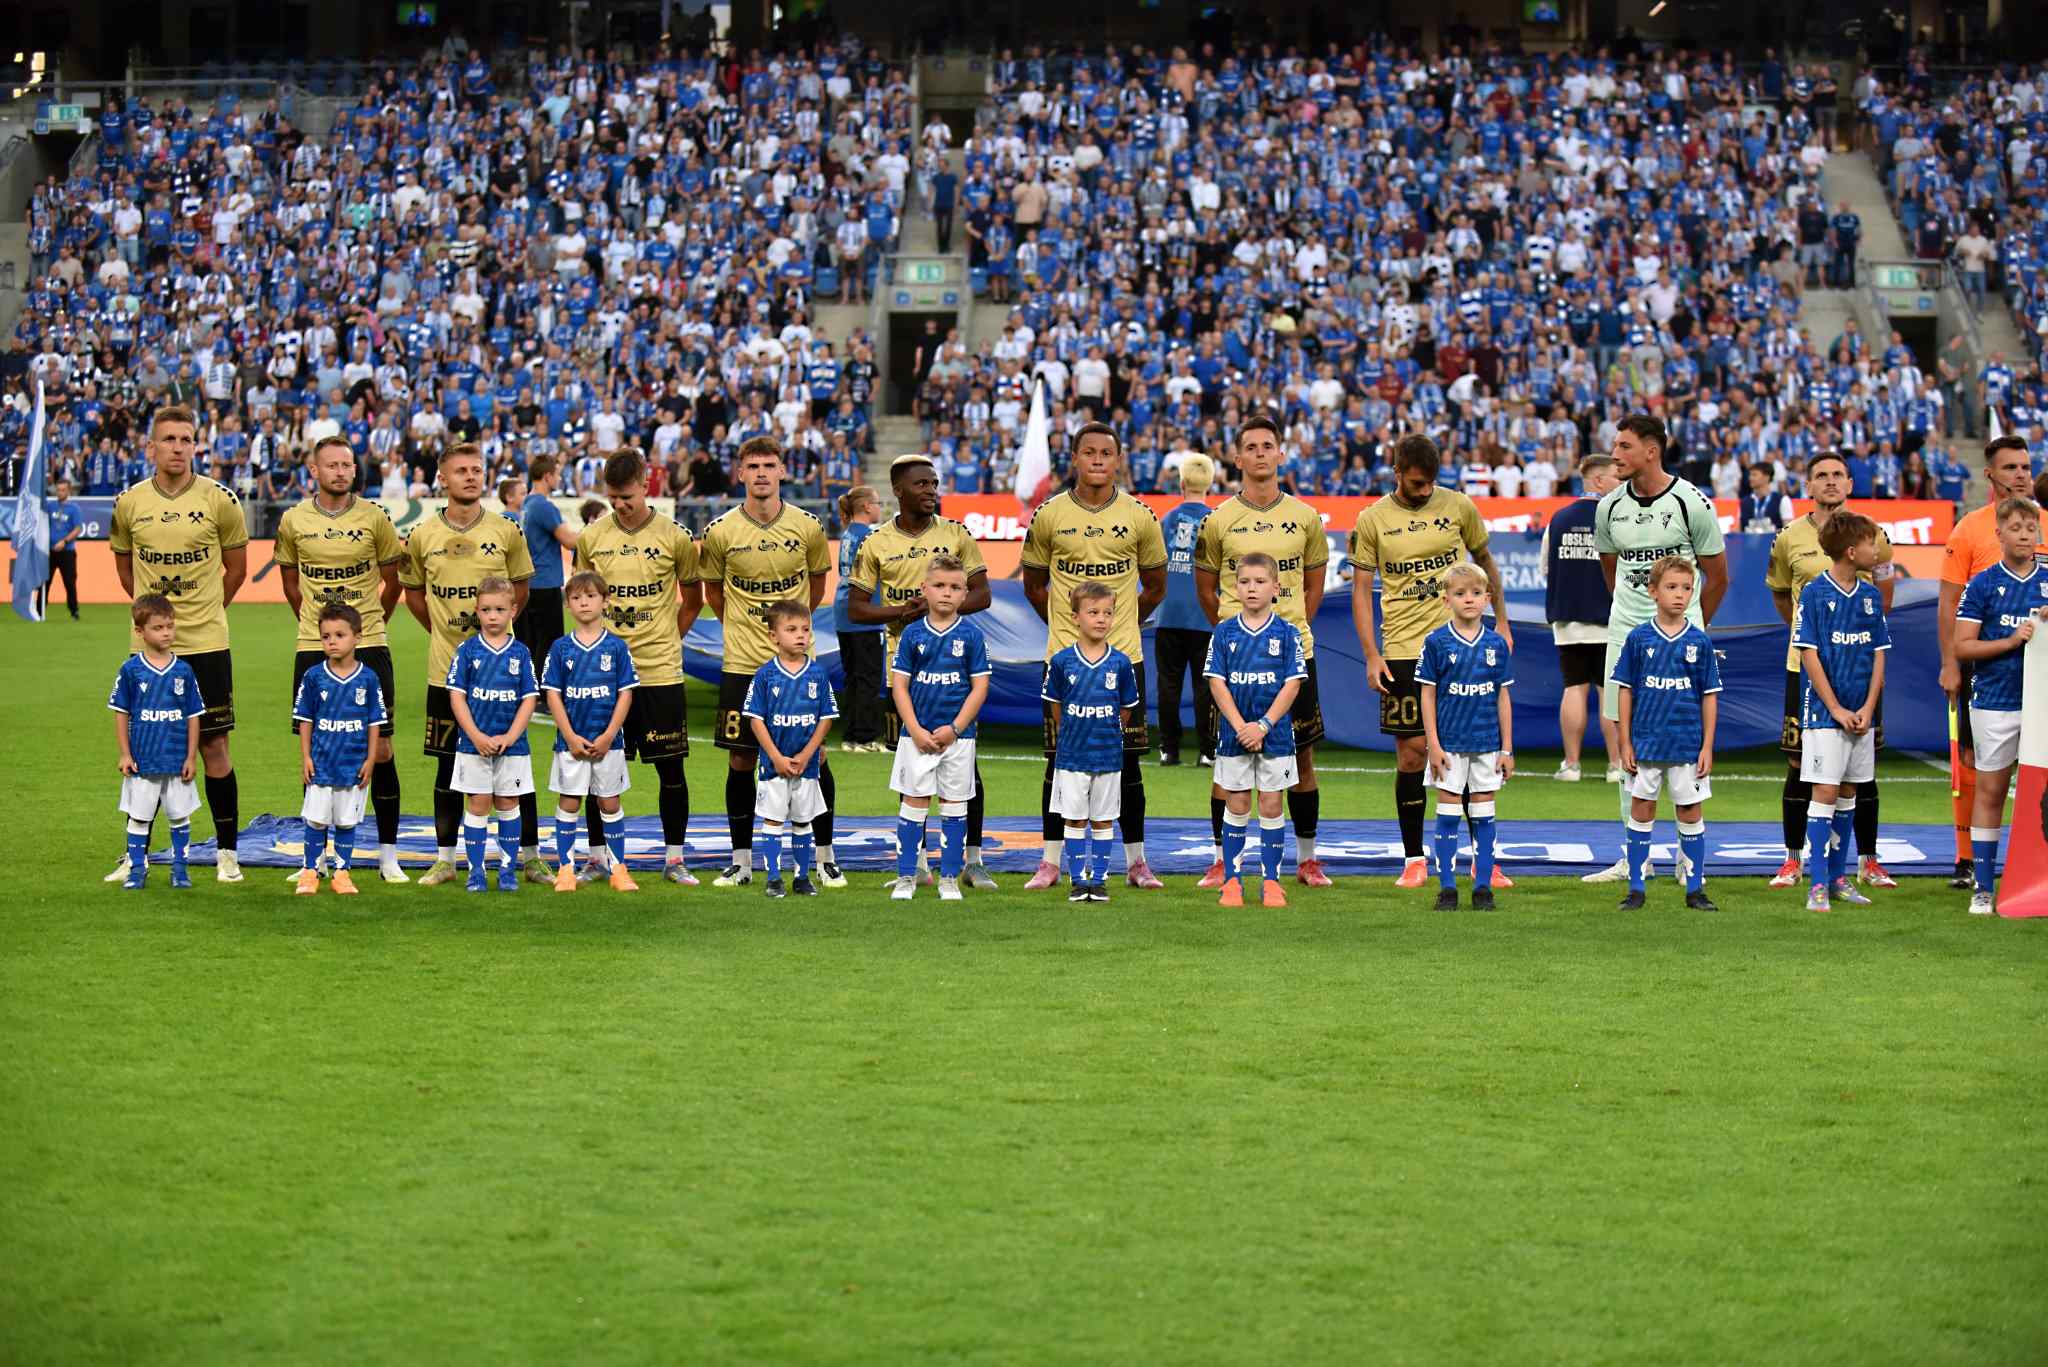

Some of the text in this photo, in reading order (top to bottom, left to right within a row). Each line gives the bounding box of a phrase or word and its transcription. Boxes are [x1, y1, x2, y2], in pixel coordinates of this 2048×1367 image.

[139, 547, 209, 565] SUPERBET
[1621, 545, 1682, 561] UPERBET
[1057, 559, 1131, 576] SUPERBET
[1385, 548, 1458, 574] SUPERBET
[300, 560, 370, 580] SUPERBET
[608, 580, 663, 598] PERBET
[732, 570, 804, 593] SUPERBET
[432, 584, 478, 599] SUPER
[916, 671, 960, 685] SUPER
[1229, 671, 1276, 684] SUPER
[1645, 675, 1692, 690] SUPER
[472, 687, 517, 702] SUPER
[566, 685, 611, 700] SUPER
[1448, 681, 1495, 696] SUPER
[141, 709, 183, 722] SUPER
[1067, 703, 1114, 719] SUPER
[1386, 695, 1418, 725] 20
[318, 718, 363, 732] SUPER
[725, 710, 740, 740] 8
[773, 713, 816, 727] SUPER
